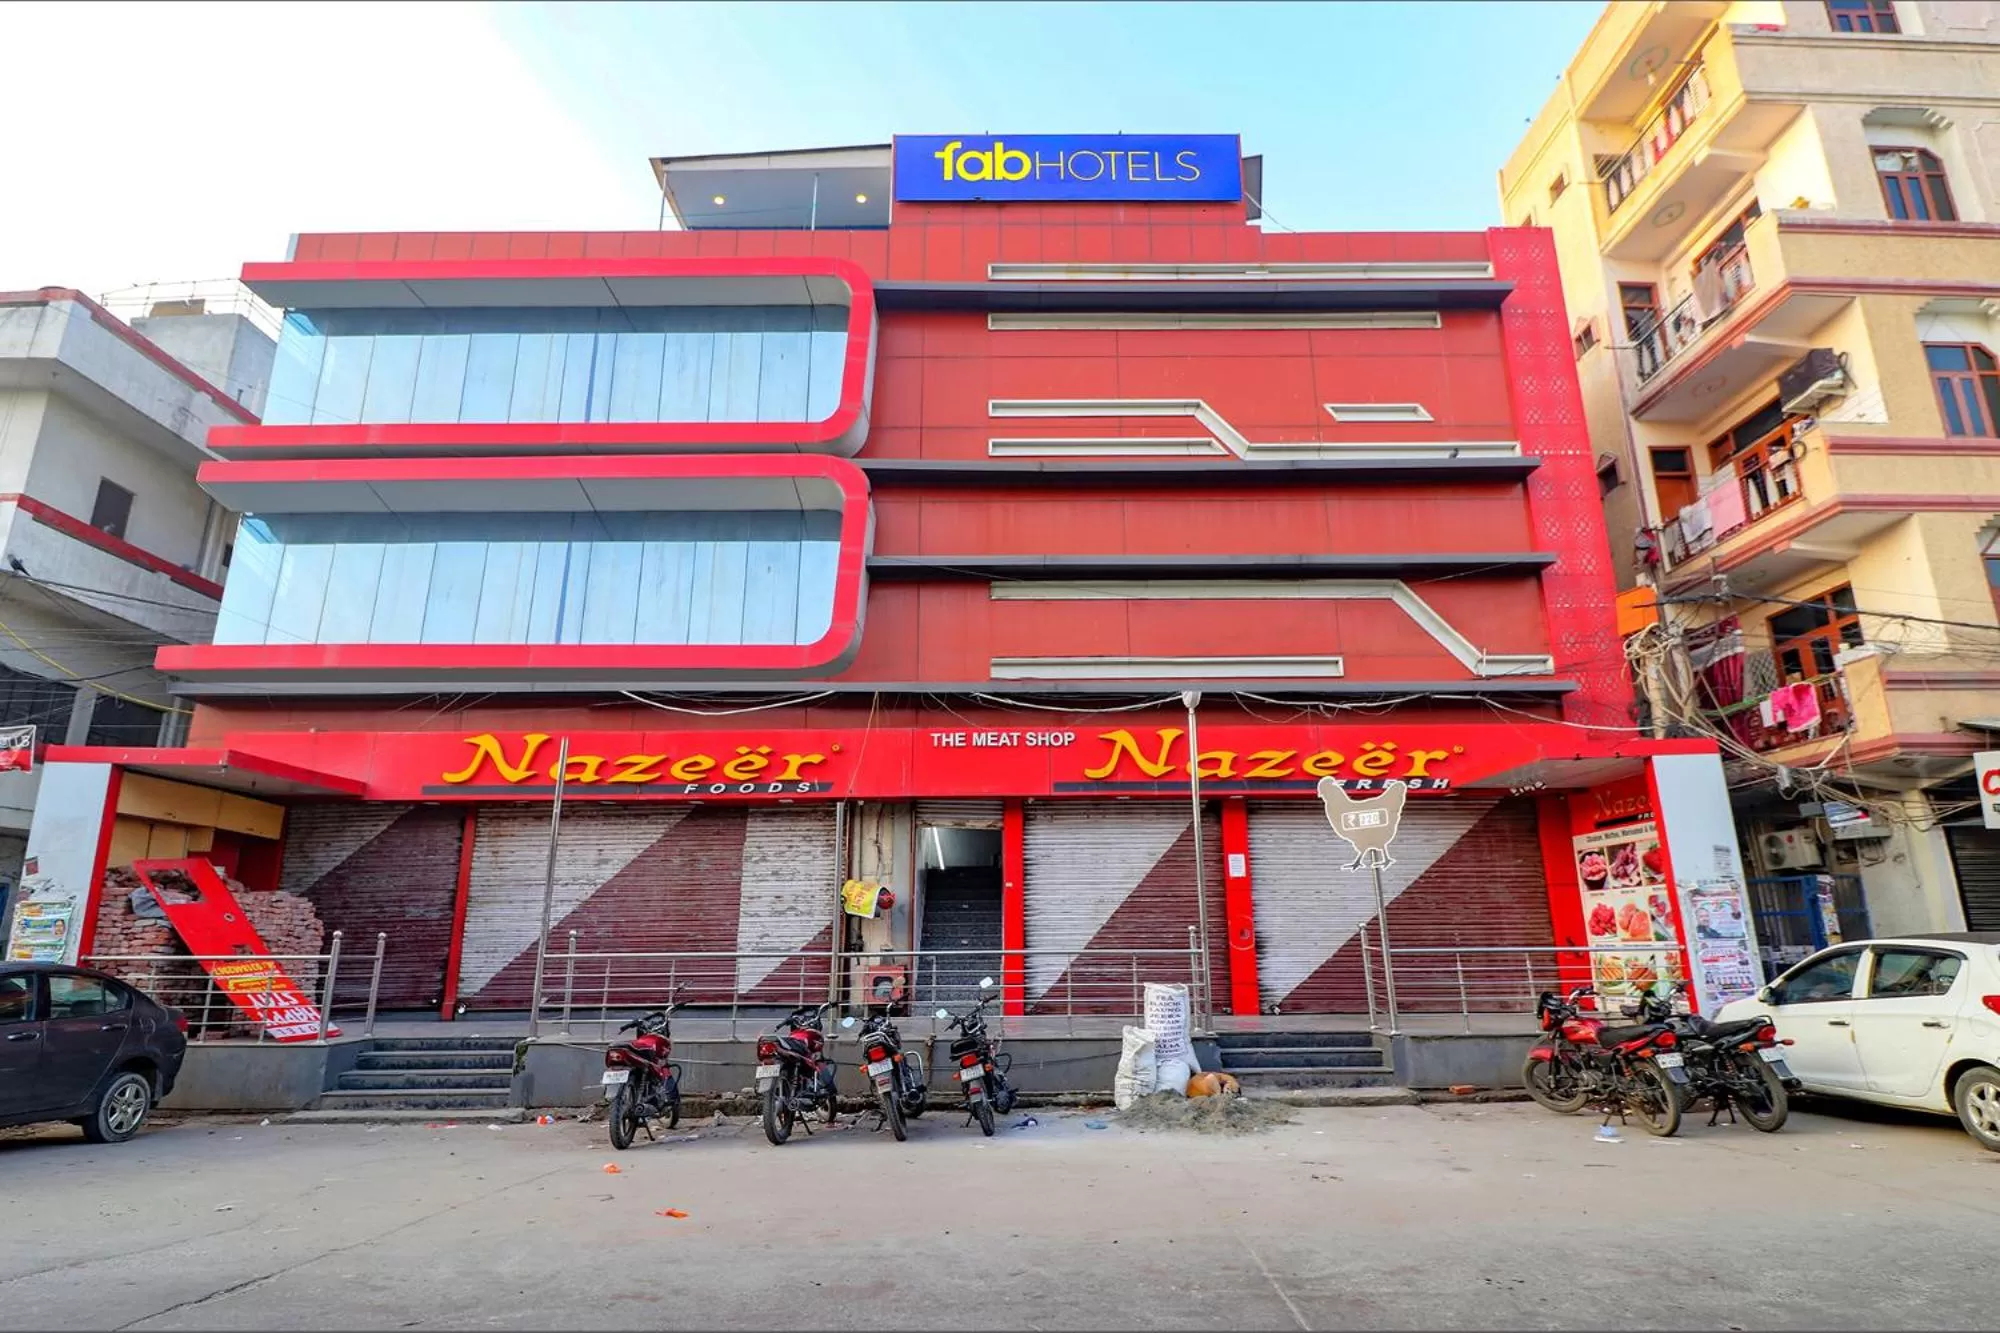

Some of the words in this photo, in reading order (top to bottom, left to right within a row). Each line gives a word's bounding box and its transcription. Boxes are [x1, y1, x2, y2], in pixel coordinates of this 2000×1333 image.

[930, 732, 966, 747] THE
[972, 731, 1020, 747] MEAT
[1025, 731, 1075, 747] SHOP
[683, 782, 811, 795] FOODS
